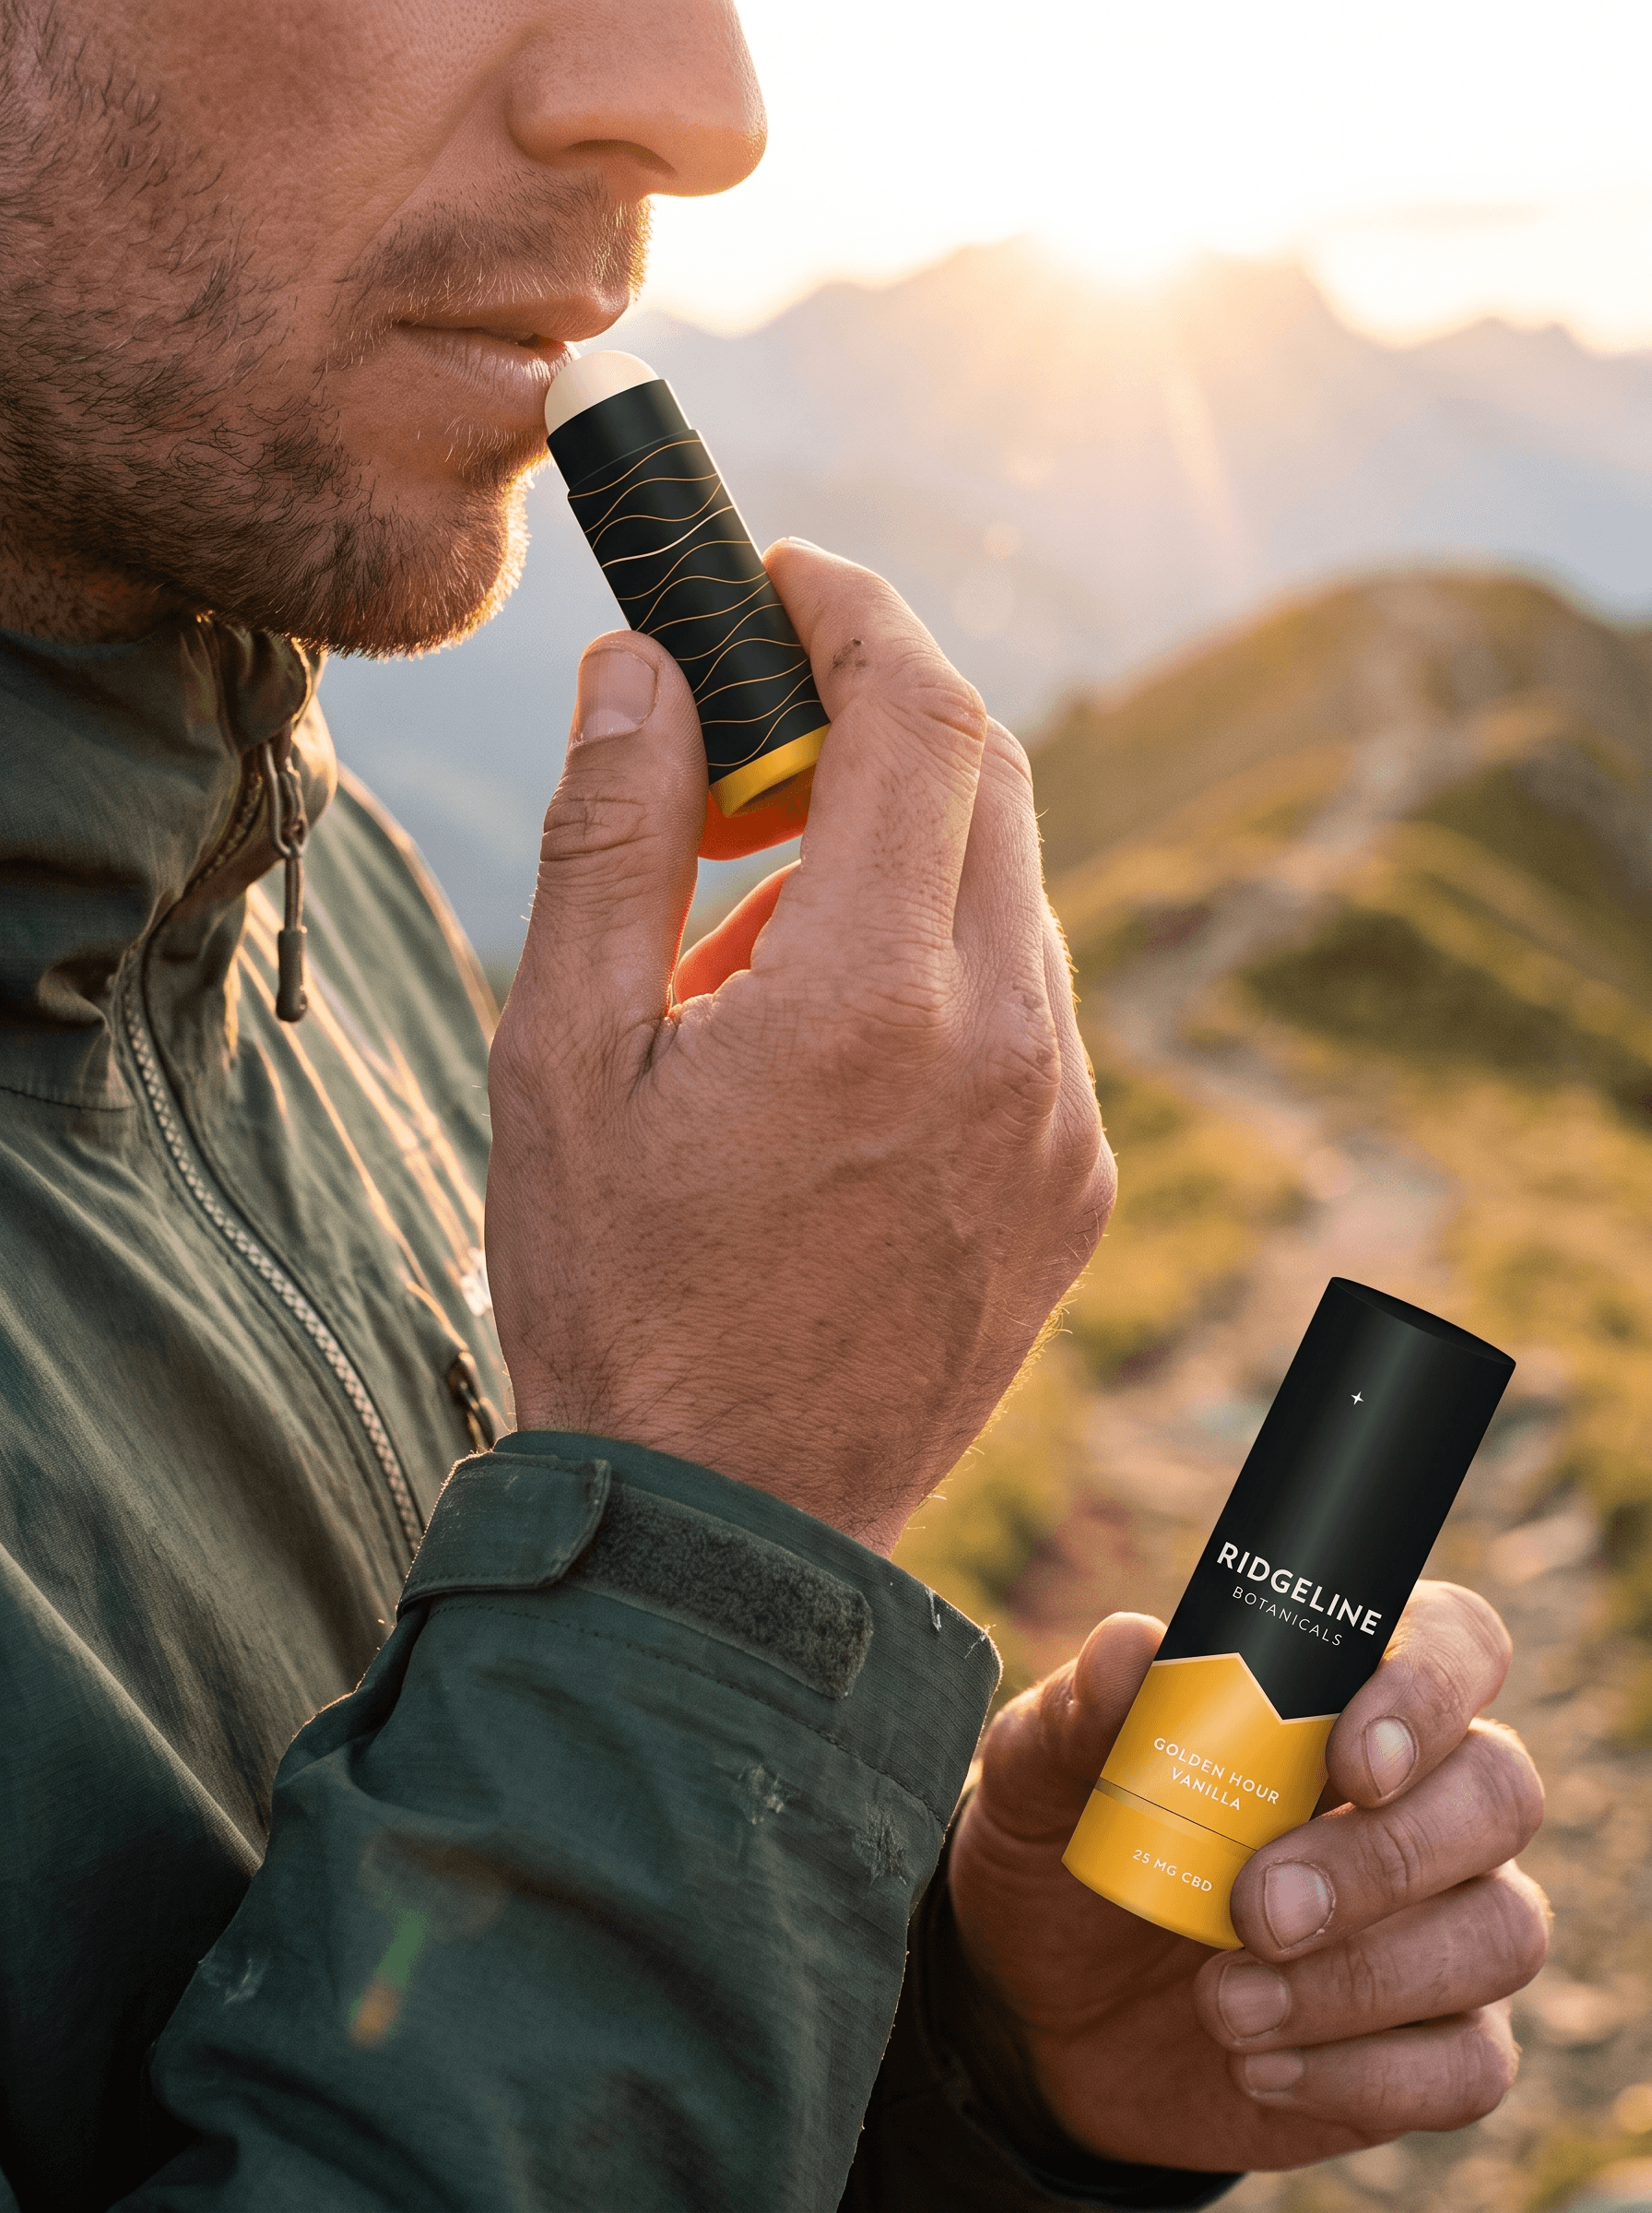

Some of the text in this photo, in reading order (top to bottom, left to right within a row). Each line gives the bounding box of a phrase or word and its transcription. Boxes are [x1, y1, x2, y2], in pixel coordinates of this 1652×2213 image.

[1216, 1541, 1383, 1636] RIDGELINE
[1232, 1586, 1343, 1647] BOTANICALS
[1153, 1737, 1280, 1805] GOLDEN HOUR
[1171, 1767, 1241, 1811] VANILLA
[1132, 1849, 1212, 1892] 25 MG CBD
